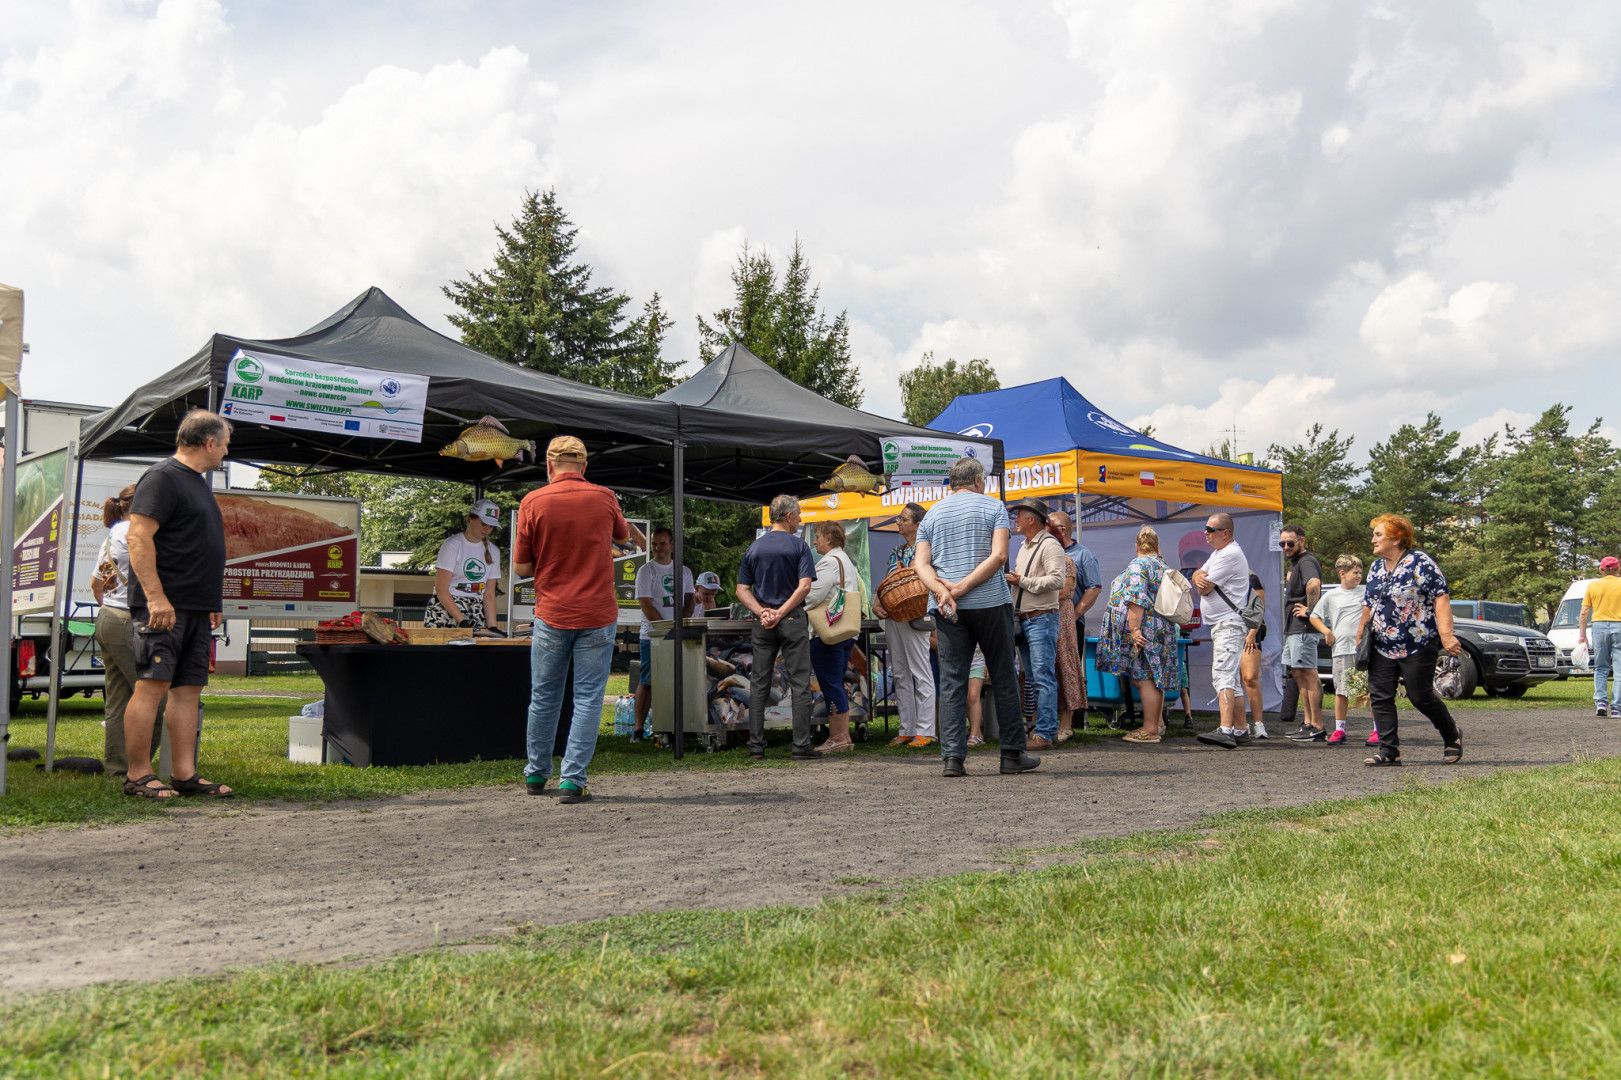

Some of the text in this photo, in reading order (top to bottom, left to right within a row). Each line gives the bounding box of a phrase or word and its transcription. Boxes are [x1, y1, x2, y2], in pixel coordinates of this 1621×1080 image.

[315, 373, 358, 384] bezpośrednia
[268, 375, 304, 386] produktów
[305, 380, 333, 391] krajowej
[334, 385, 374, 396] akwakultury
[231, 385, 264, 401] KARP
[300, 389, 318, 397] nowe
[318, 391, 347, 401] otwarcie
[327, 561, 344, 569] KARP
[224, 567, 315, 580] PROSTOTA PRZYRZĄDZANIA
